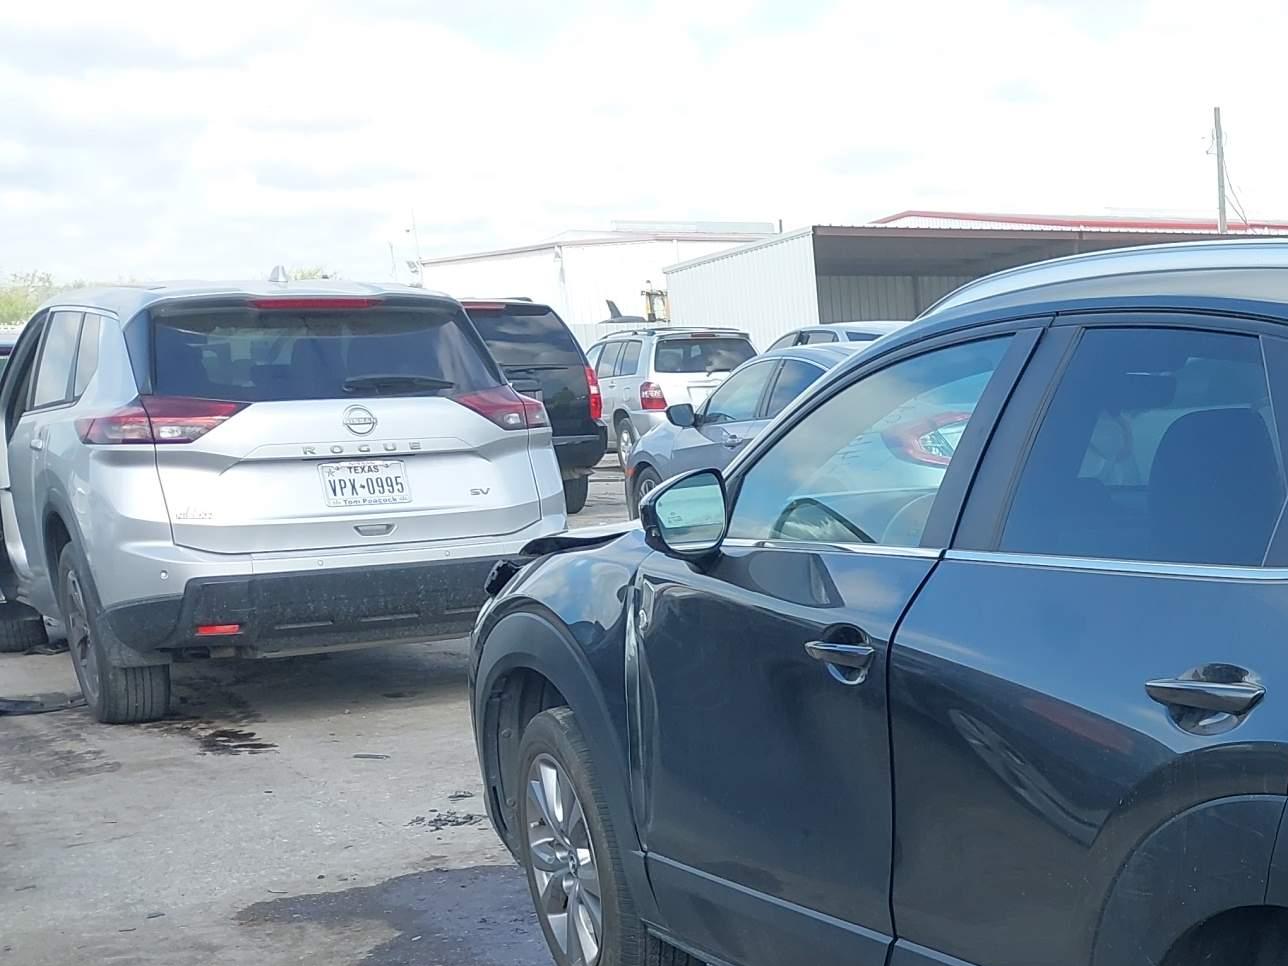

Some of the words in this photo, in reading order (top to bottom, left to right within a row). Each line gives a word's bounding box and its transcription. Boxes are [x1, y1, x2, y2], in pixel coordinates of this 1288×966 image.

[302, 442, 422, 455] ROGUE
[346, 465, 380, 474] TEXAS
[470, 487, 490, 496] SV
